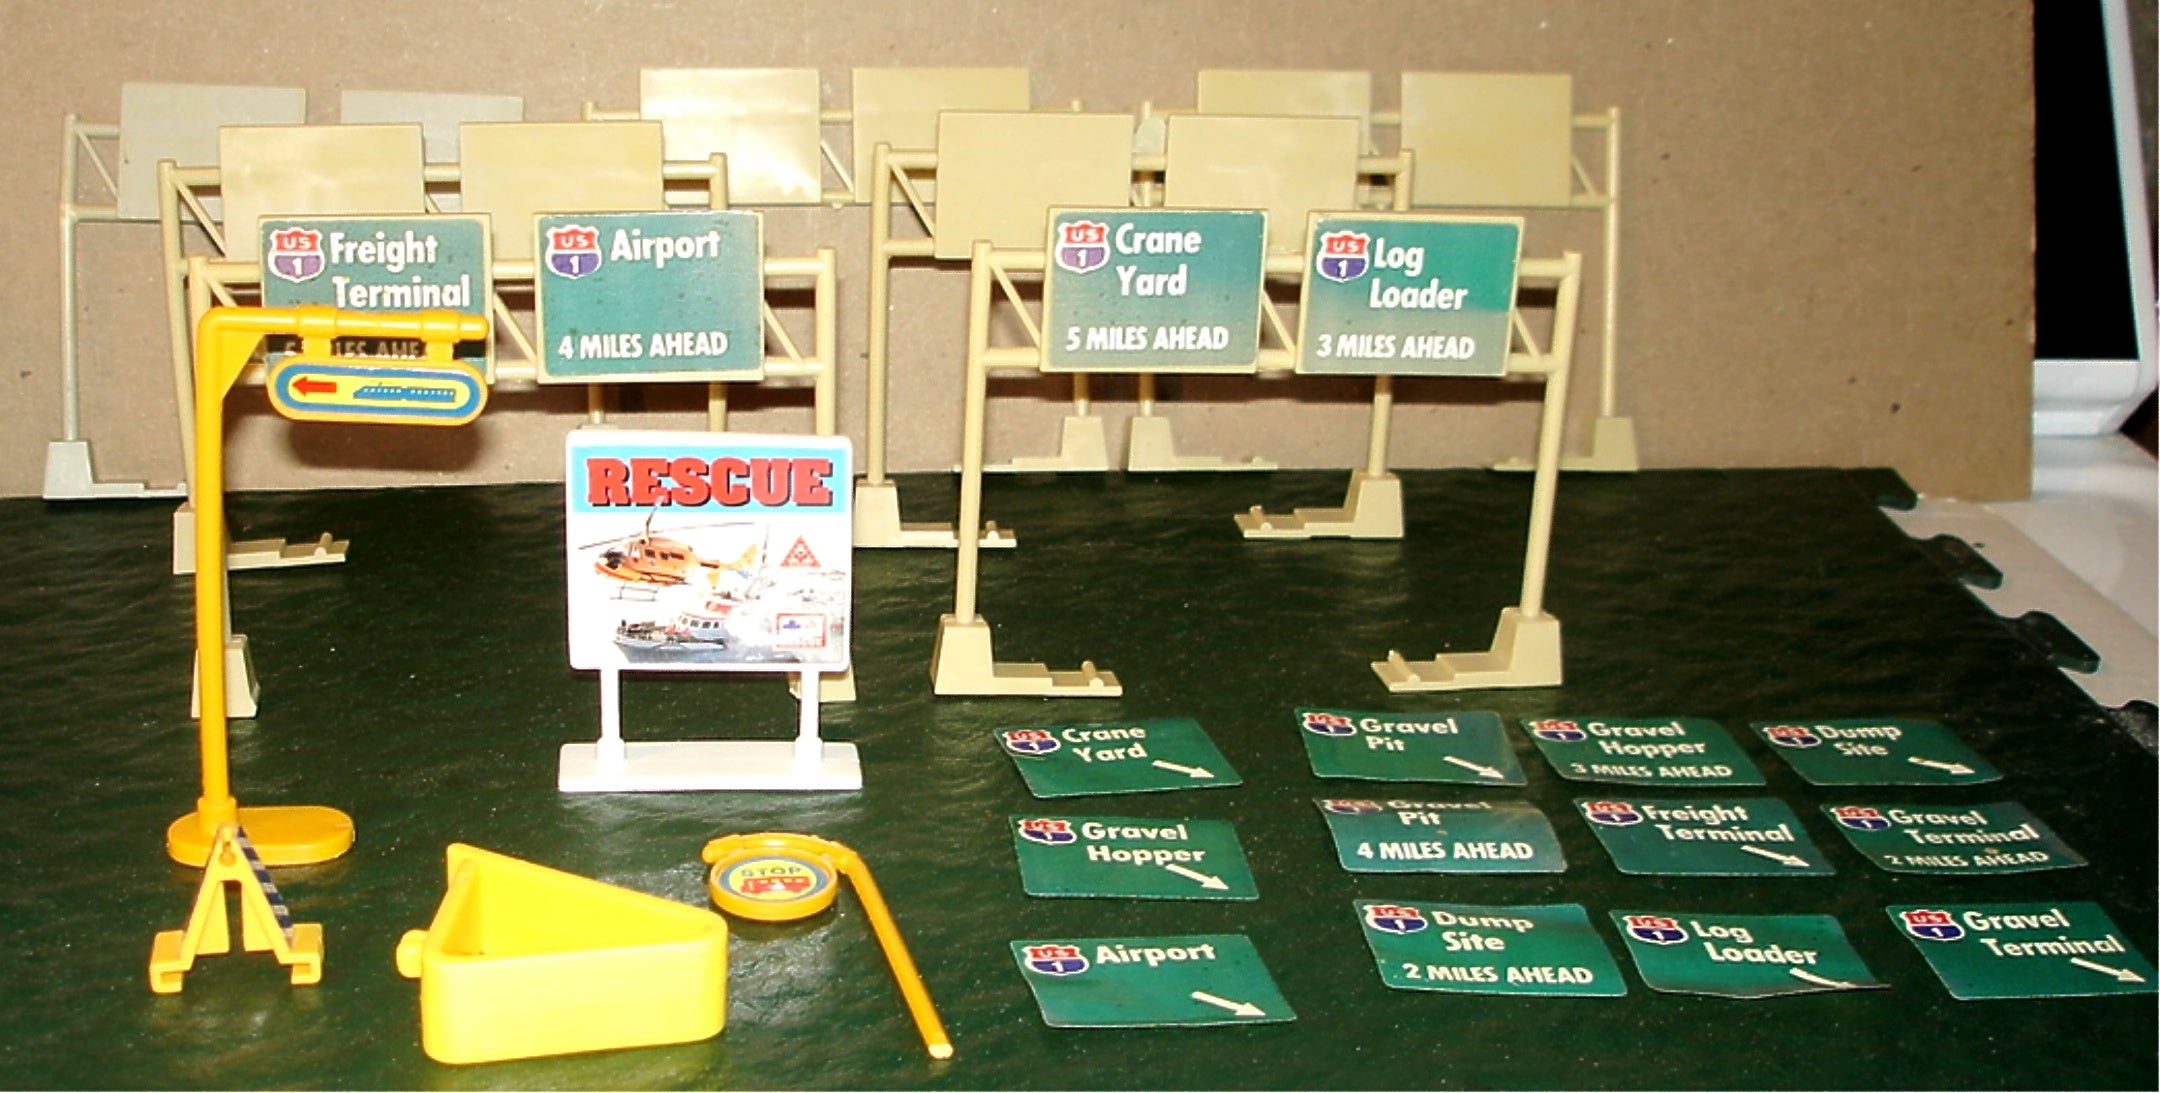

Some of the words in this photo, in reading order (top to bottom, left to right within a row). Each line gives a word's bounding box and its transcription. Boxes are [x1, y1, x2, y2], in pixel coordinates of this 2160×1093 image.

[283, 234, 311, 250] US
[561, 233, 589, 247] US
[1071, 228, 1099, 243] US
[1116, 222, 1201, 254] Crane
[330, 232, 438, 273] Freight
[611, 229, 720, 268] Airport
[1332, 239, 1359, 253] US
[292, 257, 302, 273] 1
[570, 257, 579, 273] 1
[1078, 250, 1086, 266] 1
[1374, 237, 1424, 277] Log
[1339, 259, 1348, 277] 1
[1116, 264, 1187, 296] Yard
[333, 275, 471, 309] Terminal
[1369, 278, 1468, 310] Loader
[558, 336, 574, 359] 4
[580, 334, 644, 359] MILES
[650, 333, 728, 357] AHEAD
[1066, 327, 1081, 351] 5
[1086, 327, 1148, 351] MILES
[1153, 326, 1229, 351] AHEAD
[1316, 334, 1332, 357] 3
[1336, 334, 1396, 359] MILES
[1401, 335, 1475, 360] AHEAD
[586, 457, 833, 507] RESCUE
[1062, 727, 1146, 743] Crane
[1360, 718, 1458, 734] Gravel
[1587, 721, 1686, 737] Gravel
[1814, 725, 1902, 741] Dump
[1366, 736, 1404, 750] Pit
[1598, 740, 1706, 758] Hopper
[1833, 742, 1889, 756] Site
[1073, 743, 1148, 763] Yard
[1571, 762, 1587, 774] 3
[1591, 764, 1653, 777] MILES
[1659, 765, 1733, 778] AHEAD
[1398, 812, 1440, 825] Pit
[1640, 804, 1749, 825] Freight
[1888, 809, 1988, 826] Gravel
[1082, 822, 1188, 841] Gravel
[1655, 823, 1796, 842] Terminal
[1904, 823, 2041, 844] Terminal
[1087, 845, 1206, 866] Hopper
[1357, 843, 1373, 858] 4
[1379, 842, 1446, 859] MILES
[1453, 842, 1533, 859] AHEAD
[1884, 855, 1903, 865] 2
[1905, 855, 1968, 867] MILES
[1974, 851, 2049, 867] AHEAD
[741, 866, 802, 877] STOP
[1395, 919, 1405, 930] 1
[1431, 910, 1534, 933] Dump
[1912, 912, 1943, 924] US
[1963, 908, 2071, 931] Gravel
[1690, 920, 1753, 943] Log
[1930, 927, 1943, 937] 1
[1442, 931, 1506, 951] Site
[1980, 934, 2126, 957] Terminal
[1097, 944, 1216, 966] Airport
[1703, 941, 1819, 965] Loader
[1050, 960, 1065, 973] 1
[1402, 963, 1421, 979] 2
[1427, 965, 1498, 982] MILES
[1506, 967, 1594, 984] AHEAD
